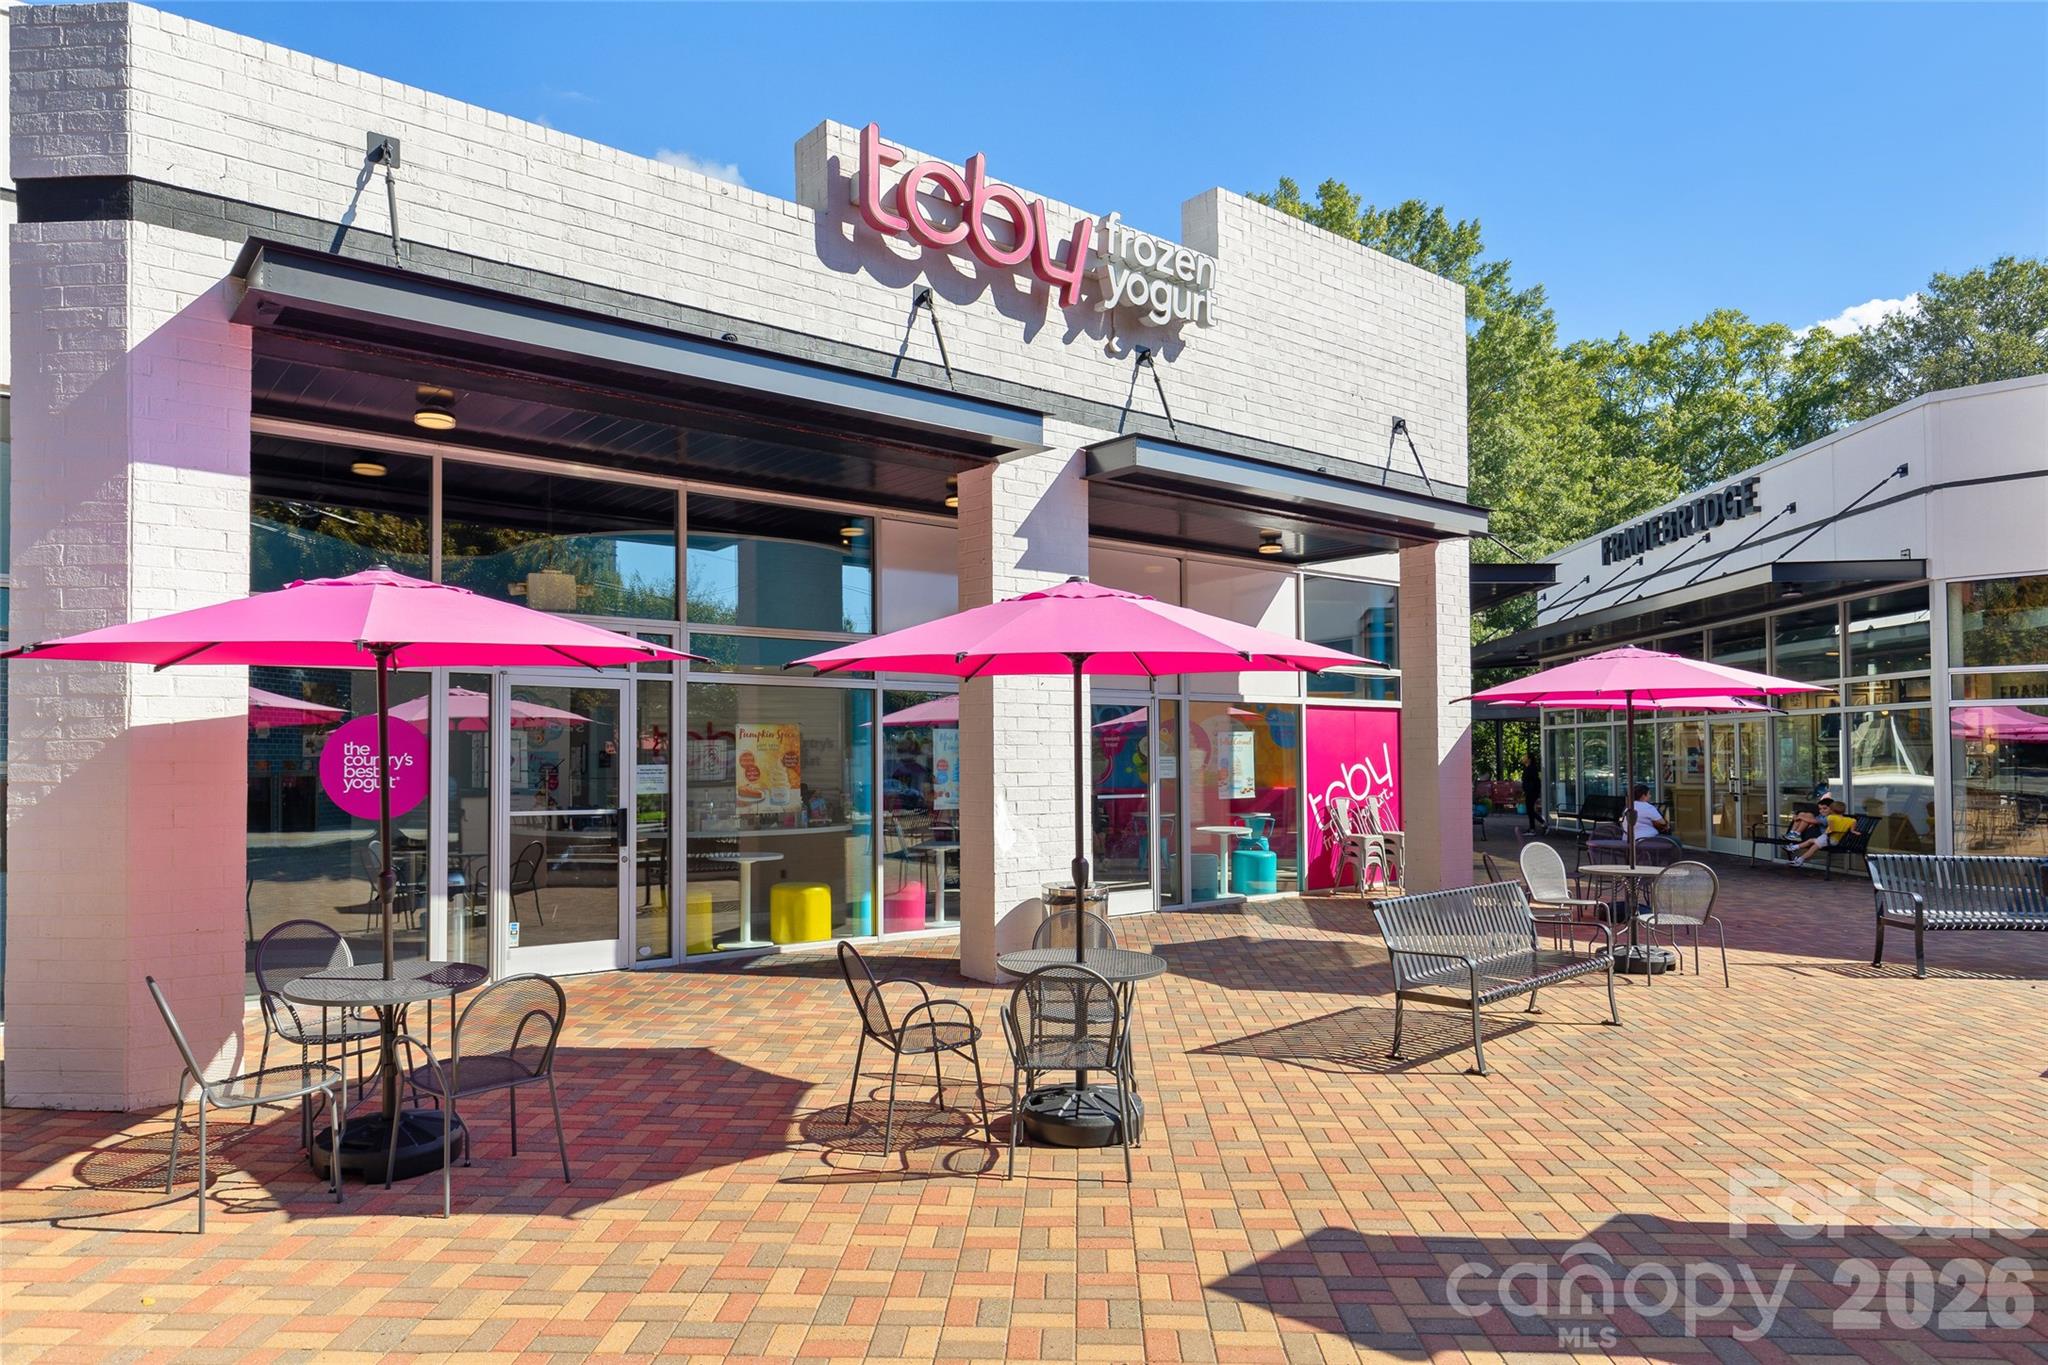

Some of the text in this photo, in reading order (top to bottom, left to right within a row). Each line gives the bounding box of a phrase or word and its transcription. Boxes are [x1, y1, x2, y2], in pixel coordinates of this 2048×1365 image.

[859, 121, 1092, 308] tcby
[1101, 211, 1217, 290] frozen
[1101, 263, 1217, 327] yogurt
[1601, 476, 1762, 566] FRAMEBRIDGE
[739, 728, 774, 742] Pumpkin
[343, 741, 370, 756] the
[343, 752, 414, 771] counry's
[343, 766, 380, 778] best
[343, 776, 396, 794] yogut
